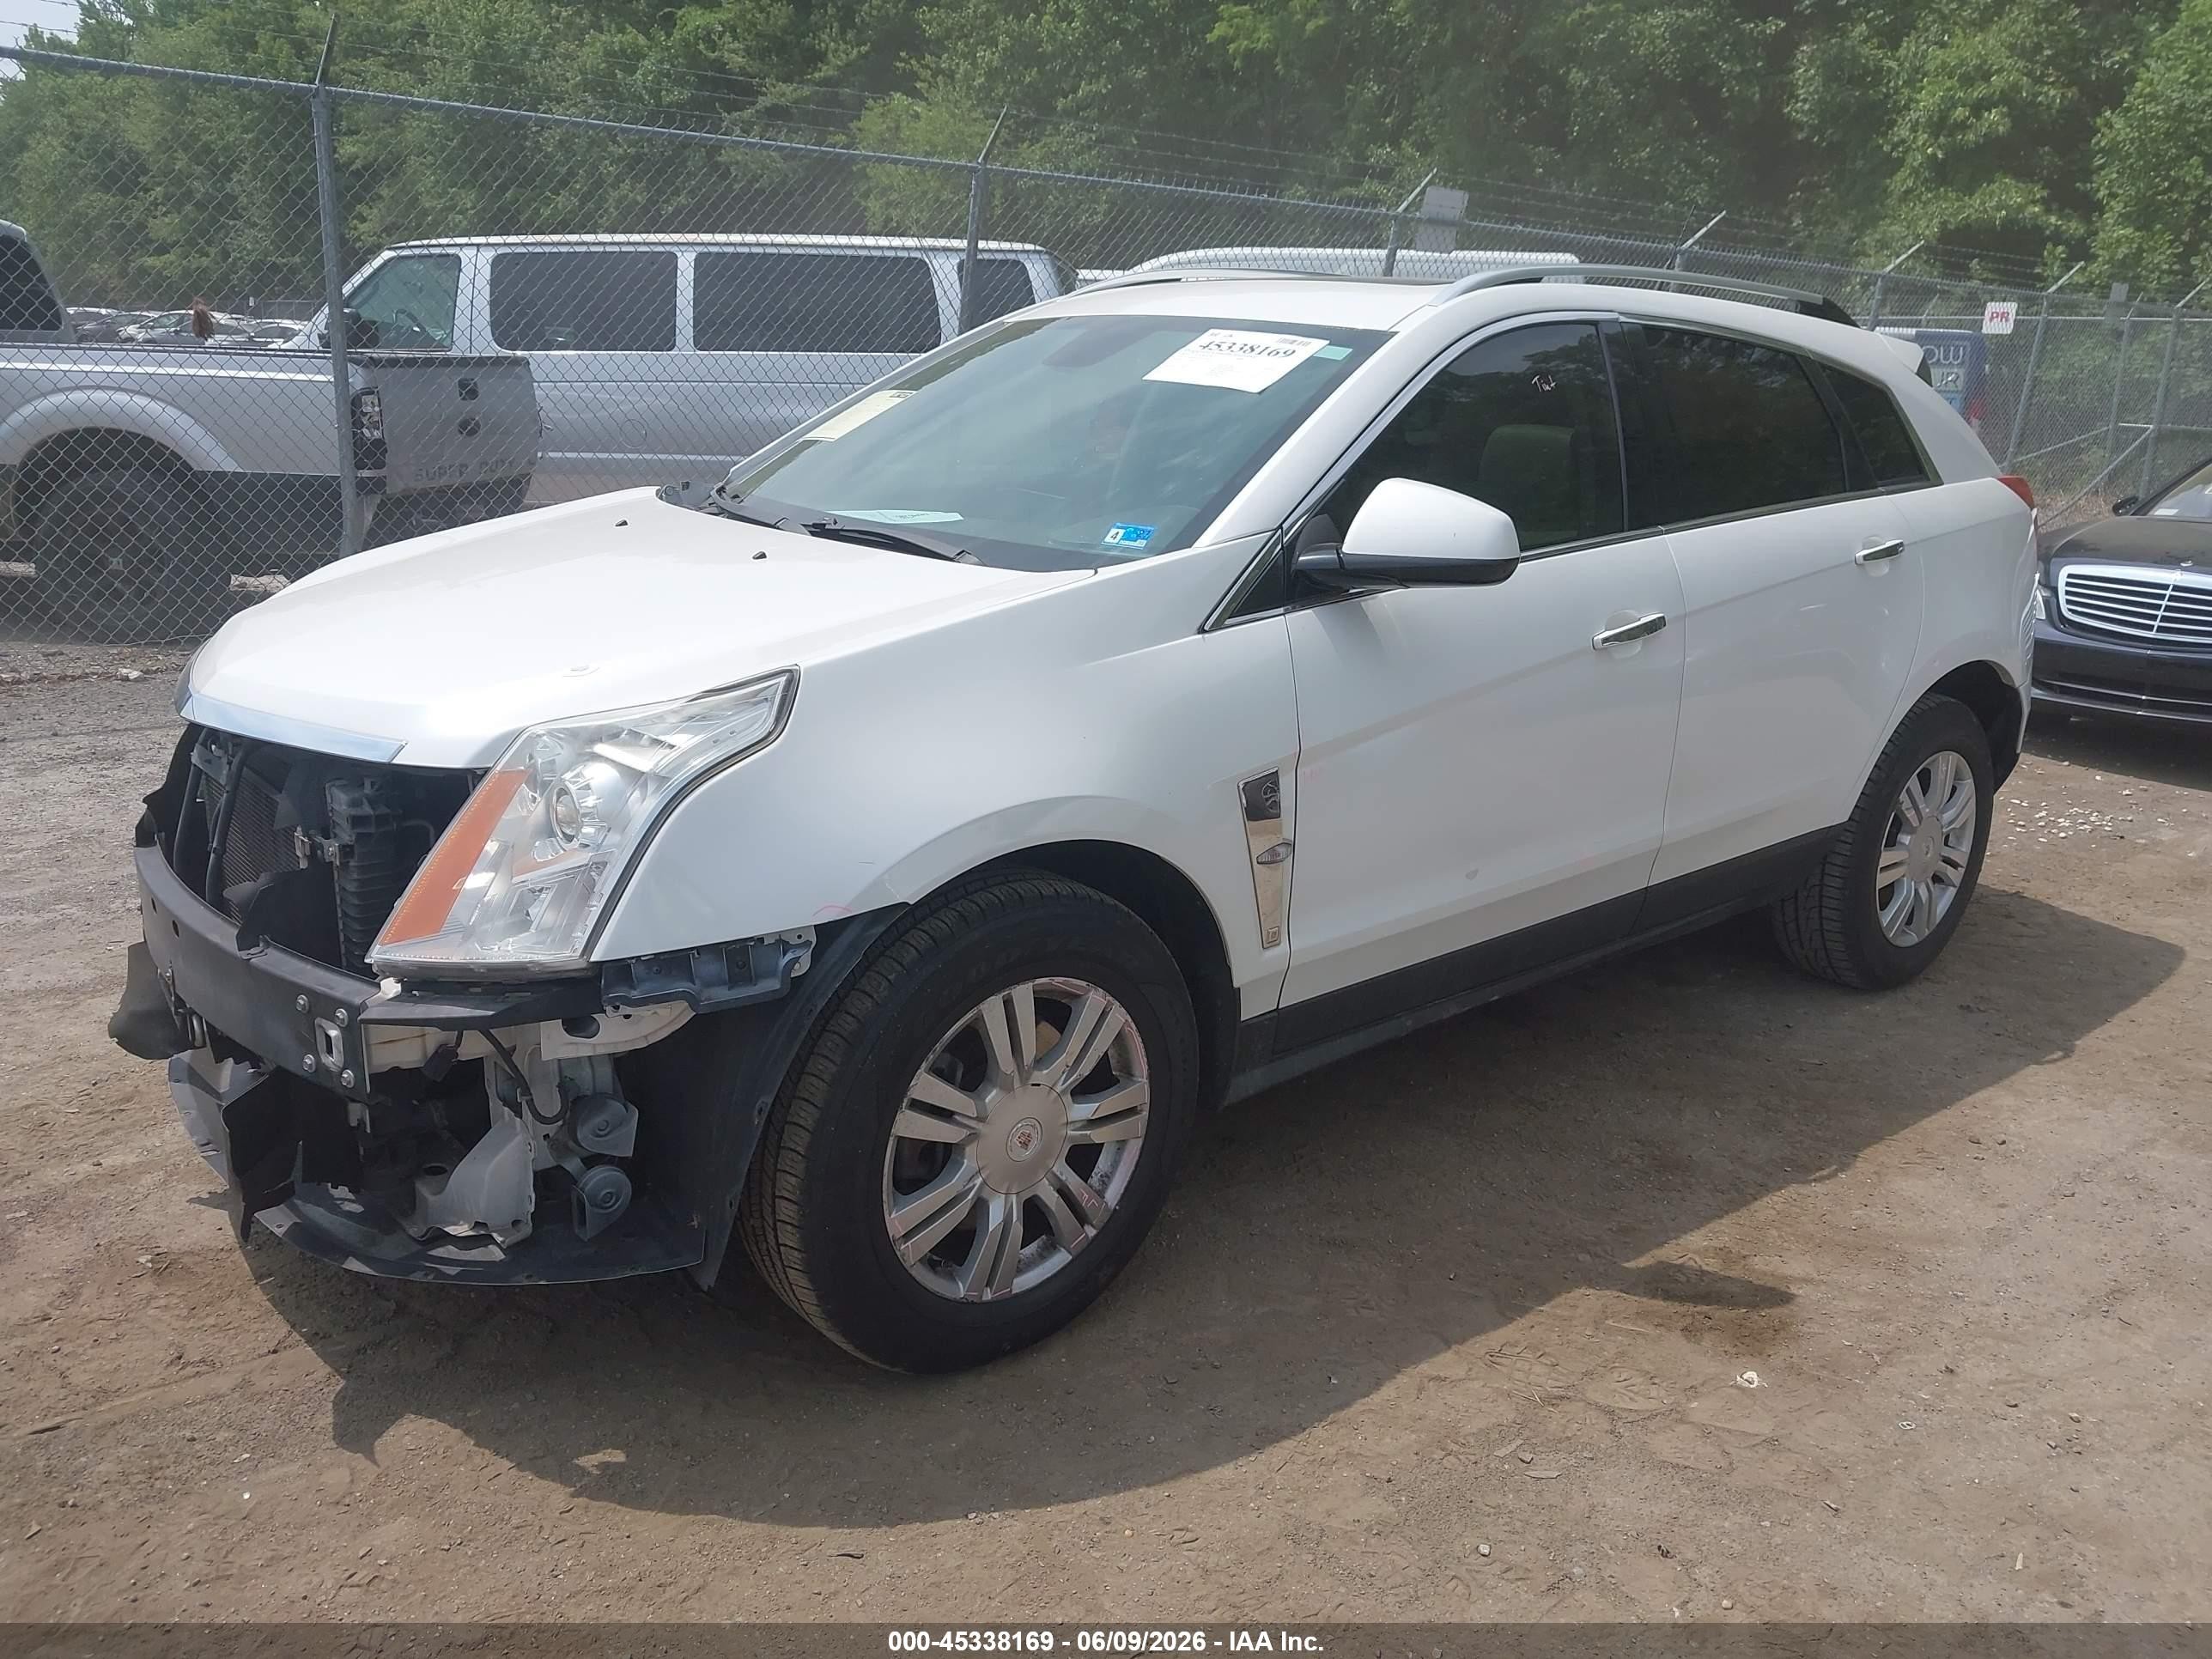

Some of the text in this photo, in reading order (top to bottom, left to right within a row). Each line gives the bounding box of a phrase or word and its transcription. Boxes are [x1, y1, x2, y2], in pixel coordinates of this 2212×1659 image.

[1990, 312, 2010, 323] PR
[1199, 340, 1296, 358] 45338169
[413, 463, 469, 483] SUPER
[1110, 531, 1120, 541] 4
